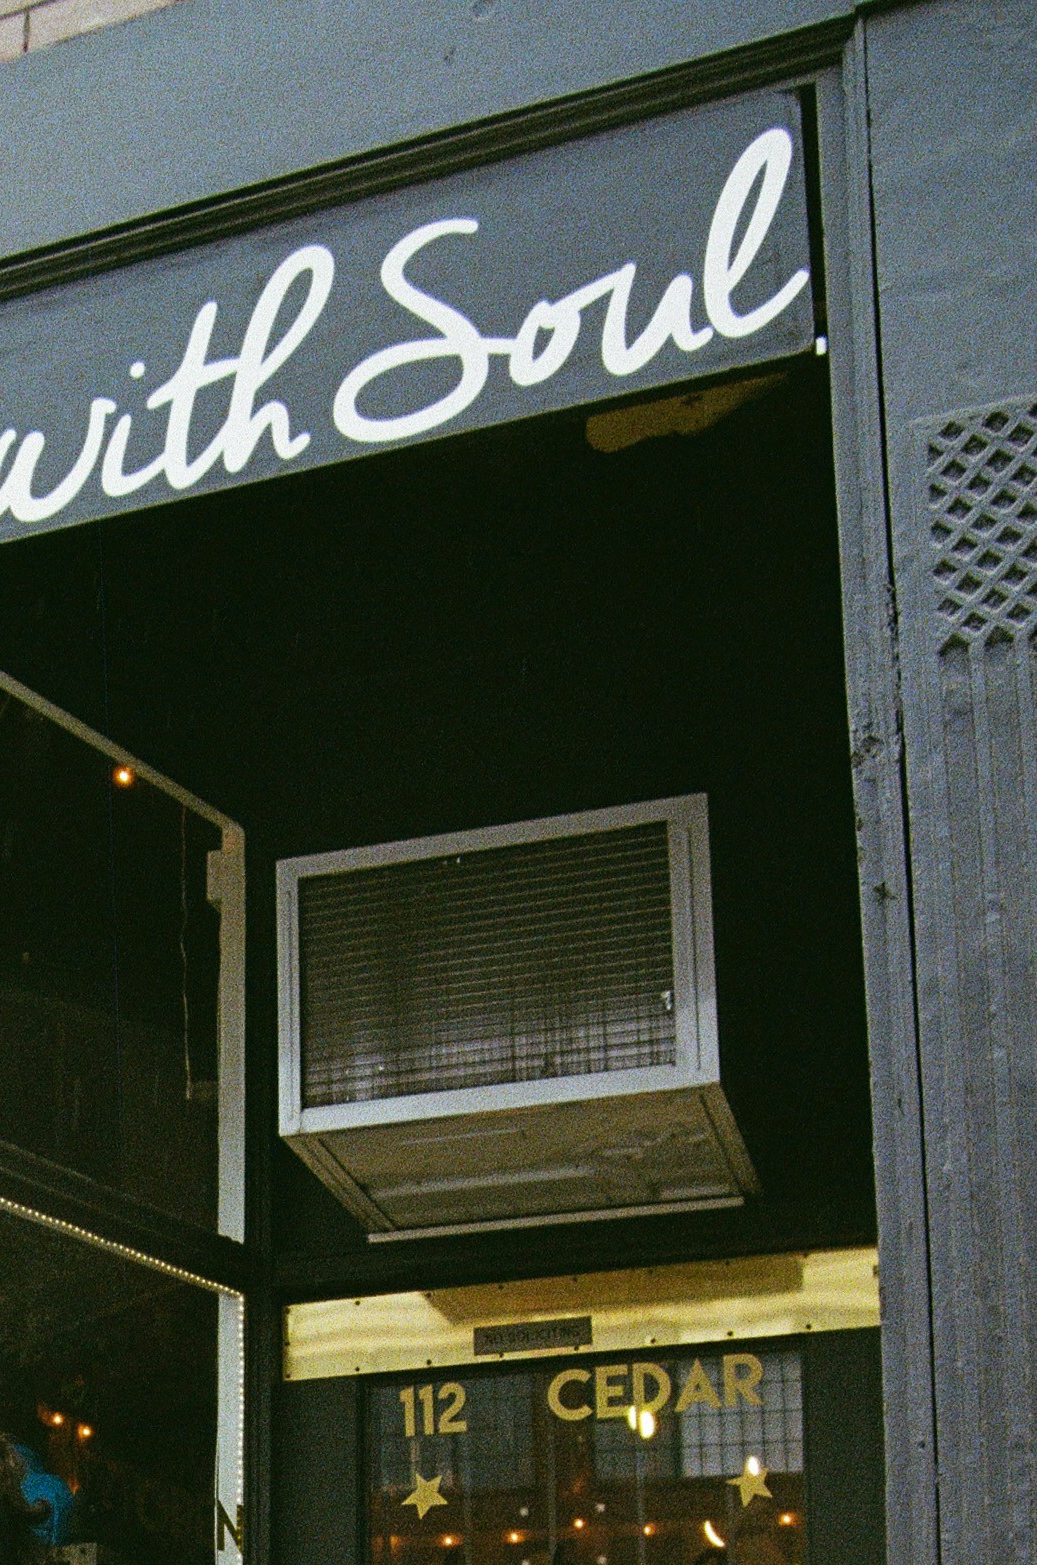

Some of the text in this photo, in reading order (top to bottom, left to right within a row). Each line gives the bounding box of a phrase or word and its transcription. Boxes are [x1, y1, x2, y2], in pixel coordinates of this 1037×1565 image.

[332, 128, 810, 444] Soul
[399, 1352, 764, 1438] 112 CEDAR
